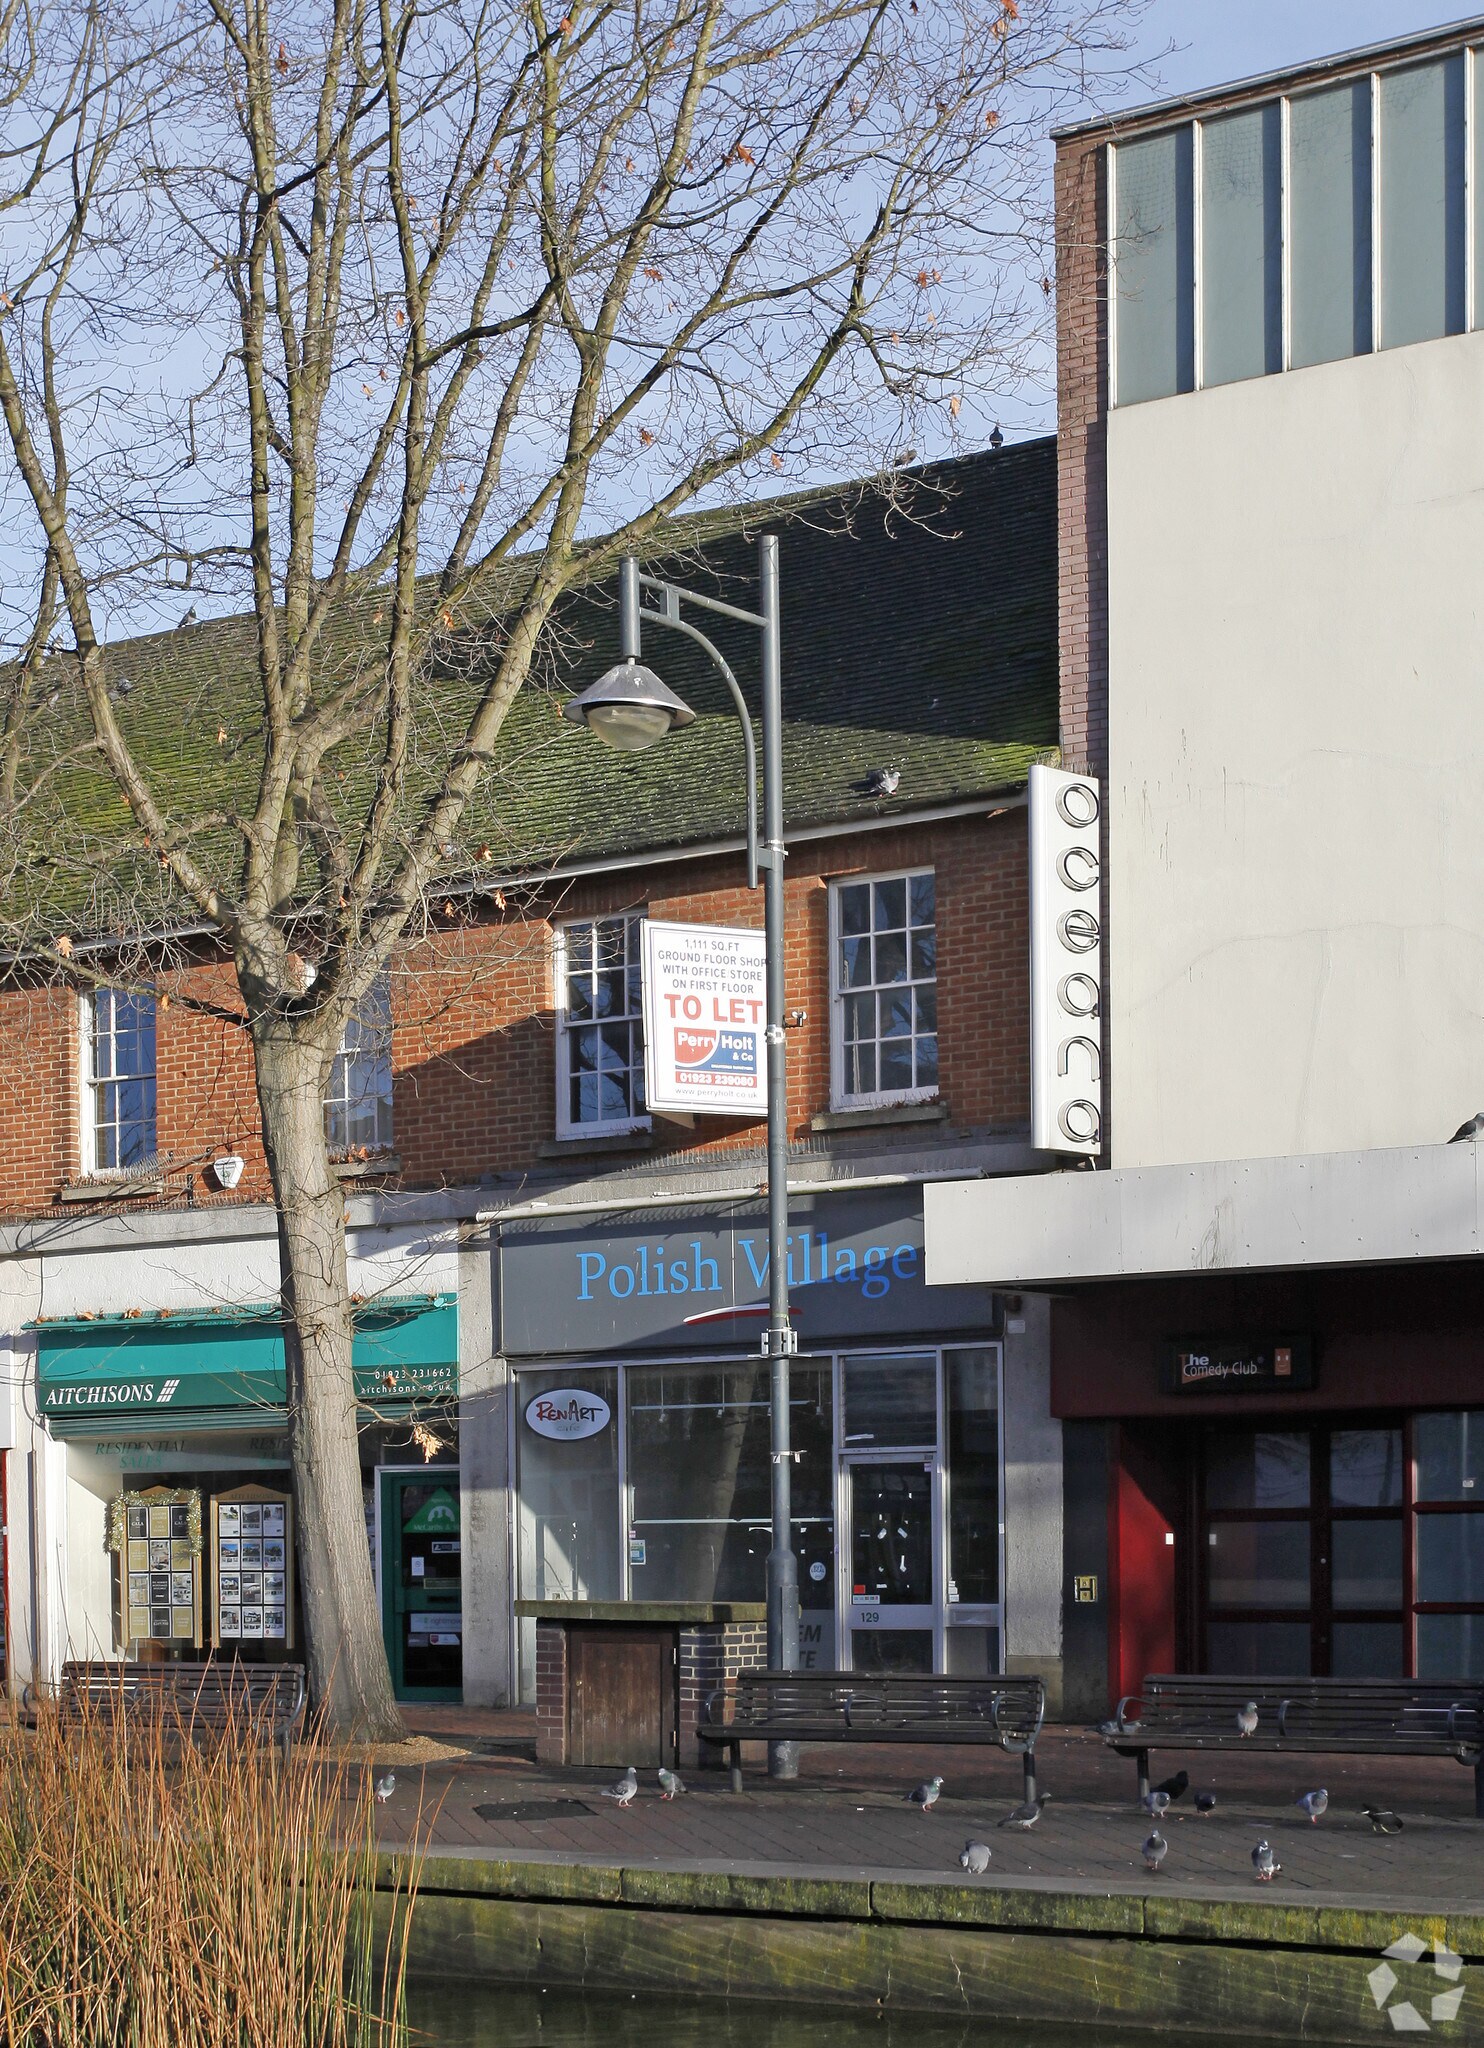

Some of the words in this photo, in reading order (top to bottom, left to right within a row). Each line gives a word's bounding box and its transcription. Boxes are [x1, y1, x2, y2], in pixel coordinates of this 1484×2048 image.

[685, 939, 707, 950] 1,111
[711, 940, 740, 952] SQ.FT
[658, 950, 701, 963] GROUND
[704, 954, 737, 966] FLOOR
[739, 957, 767, 968] SHOP
[663, 964, 688, 975] WITH
[691, 966, 727, 979] OFFICE
[730, 969, 762, 981] STORE
[672, 978, 687, 989] ON
[690, 980, 718, 991] FIRST
[721, 982, 754, 994] FLOOR
[664, 993, 702, 1020] TO
[713, 997, 763, 1025] LET
[677, 1031, 717, 1049] Perry
[721, 1034, 754, 1051] Holt
[732, 1051, 740, 1061] &
[741, 1052, 754, 1062] Co
[680, 1072, 713, 1084] 01923
[576, 1241, 723, 1300] Polish
[738, 1232, 918, 1299] Village
[374, 1369, 407, 1380] 01923
[412, 1368, 452, 1378] 231662
[1183, 1363, 1229, 1379] Comedy
[1232, 1361, 1258, 1375] Club
[45, 1383, 155, 1405] AITCHISONS
[95, 1440, 185, 1455] RESIDENTIAL
[860, 1612, 880, 1623] 129
